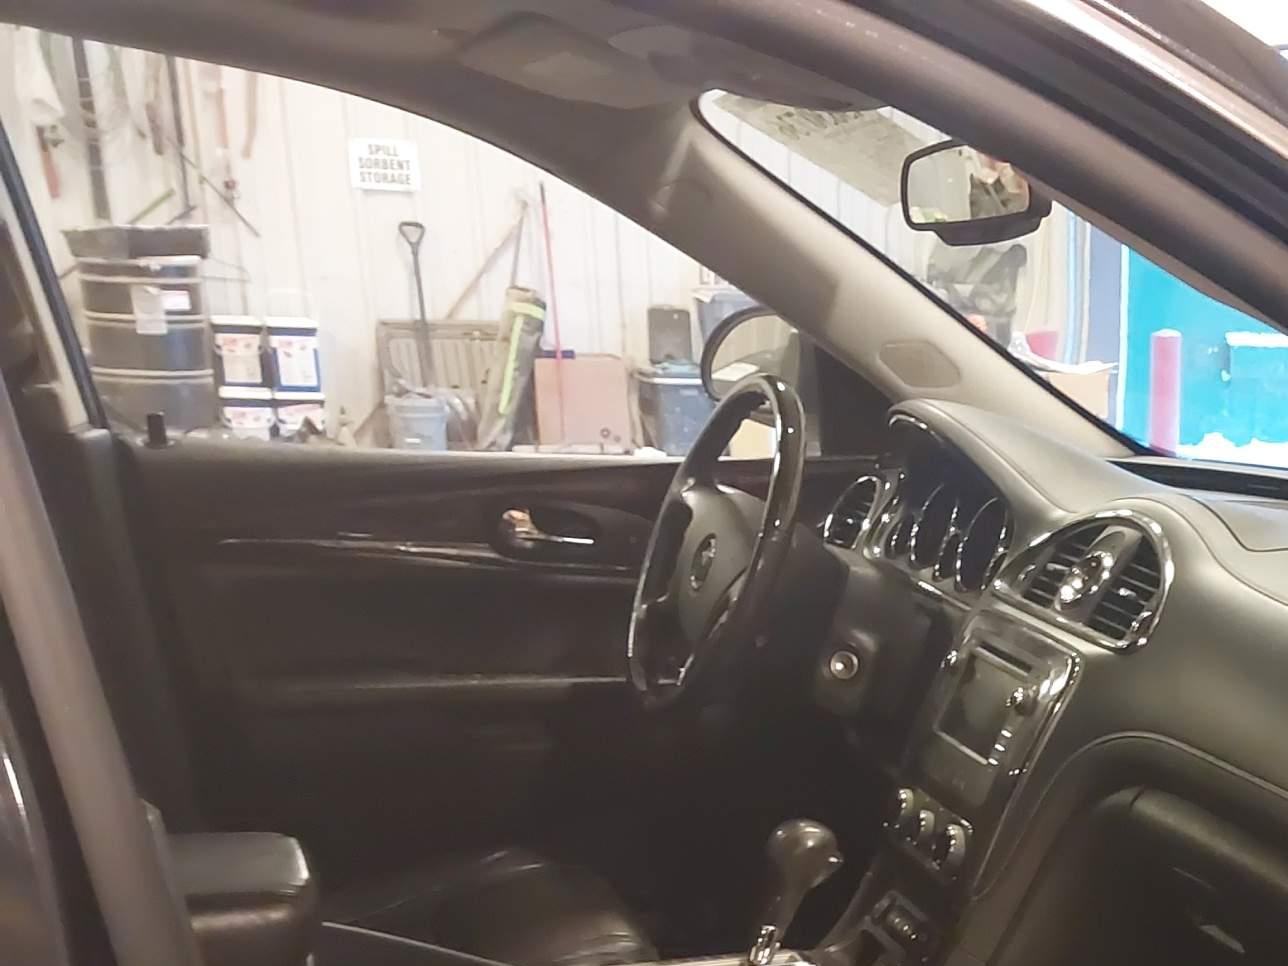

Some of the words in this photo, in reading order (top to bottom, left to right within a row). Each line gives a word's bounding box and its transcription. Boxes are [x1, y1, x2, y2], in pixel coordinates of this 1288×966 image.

[368, 144, 399, 157] SPILL
[358, 157, 411, 171] SORBENT
[359, 171, 412, 185] STORAGE
